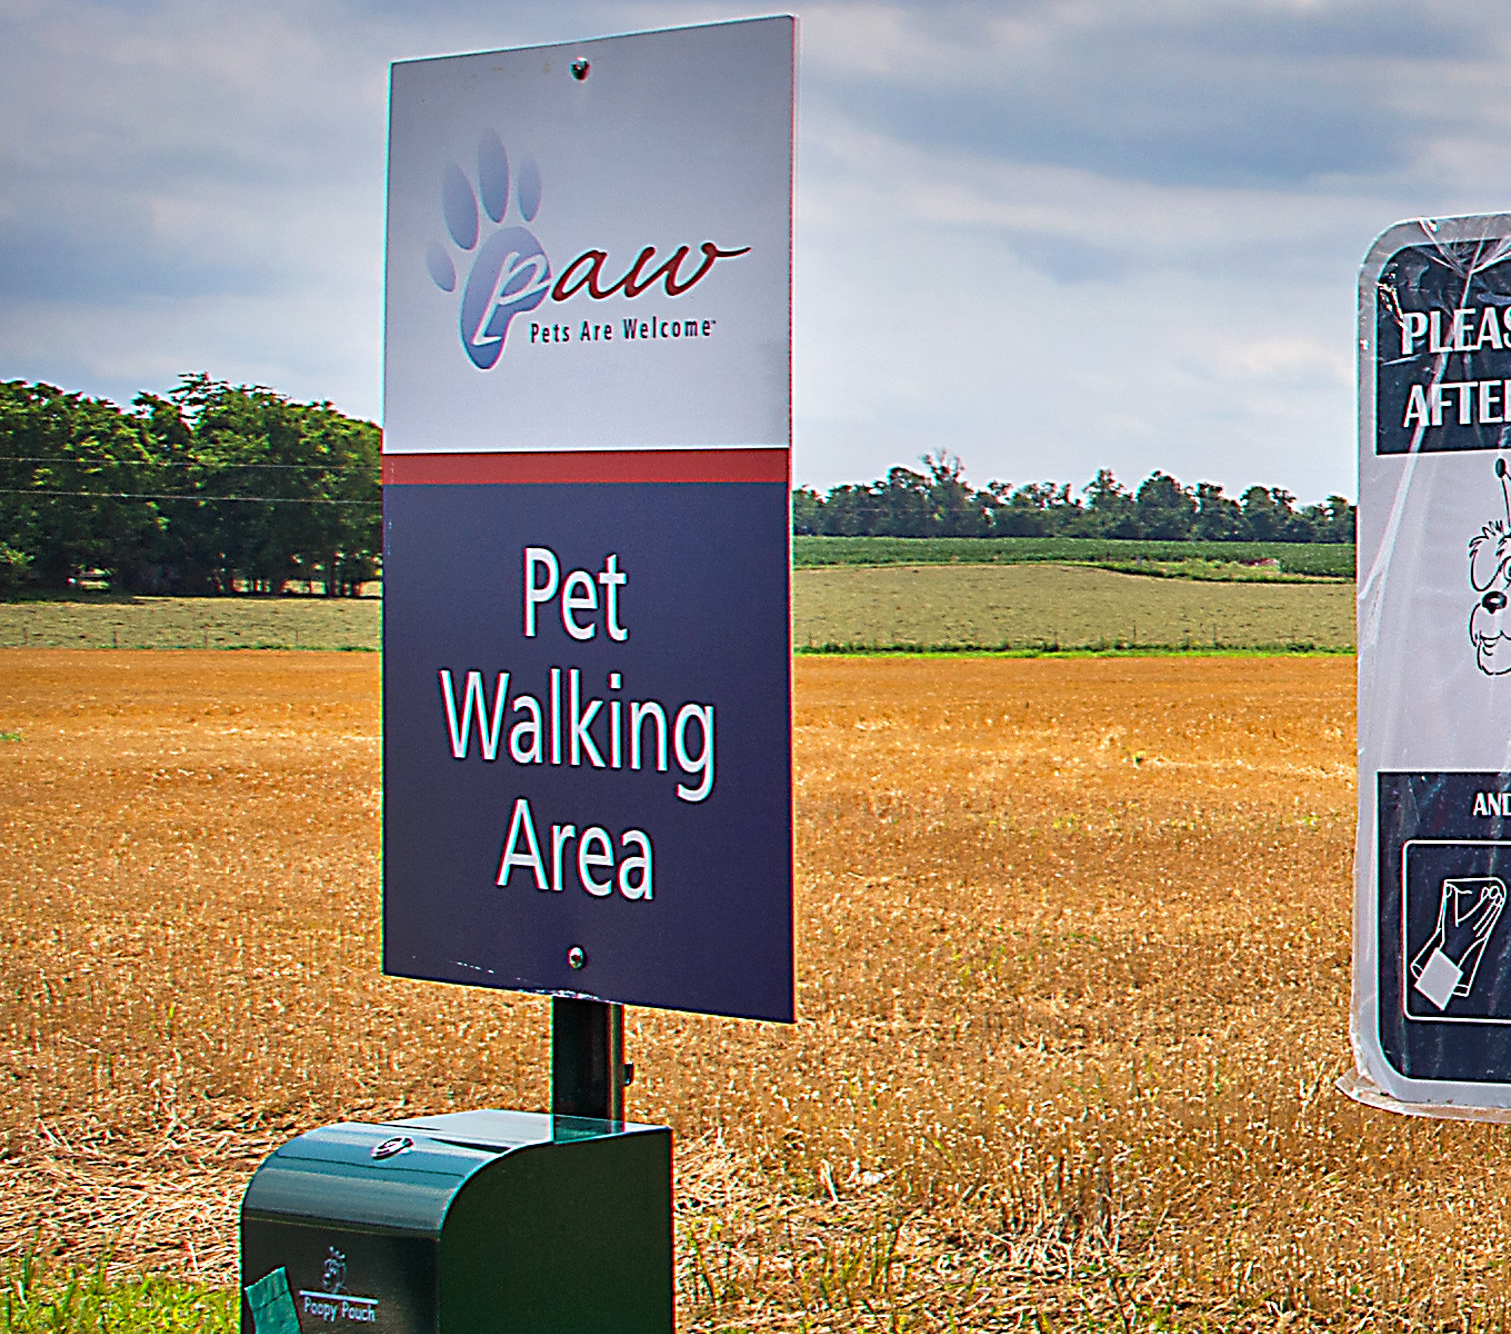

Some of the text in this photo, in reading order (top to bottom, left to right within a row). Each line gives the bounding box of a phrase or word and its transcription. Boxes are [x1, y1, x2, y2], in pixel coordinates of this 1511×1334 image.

[472, 241, 752, 346] paw
[530, 322, 570, 344] Pets
[580, 320, 613, 342] Are
[522, 547, 629, 641] Pet
[440, 668, 715, 801] Walking
[496, 799, 654, 901] Area
[304, 1296, 375, 1321] Poopy Pouch
